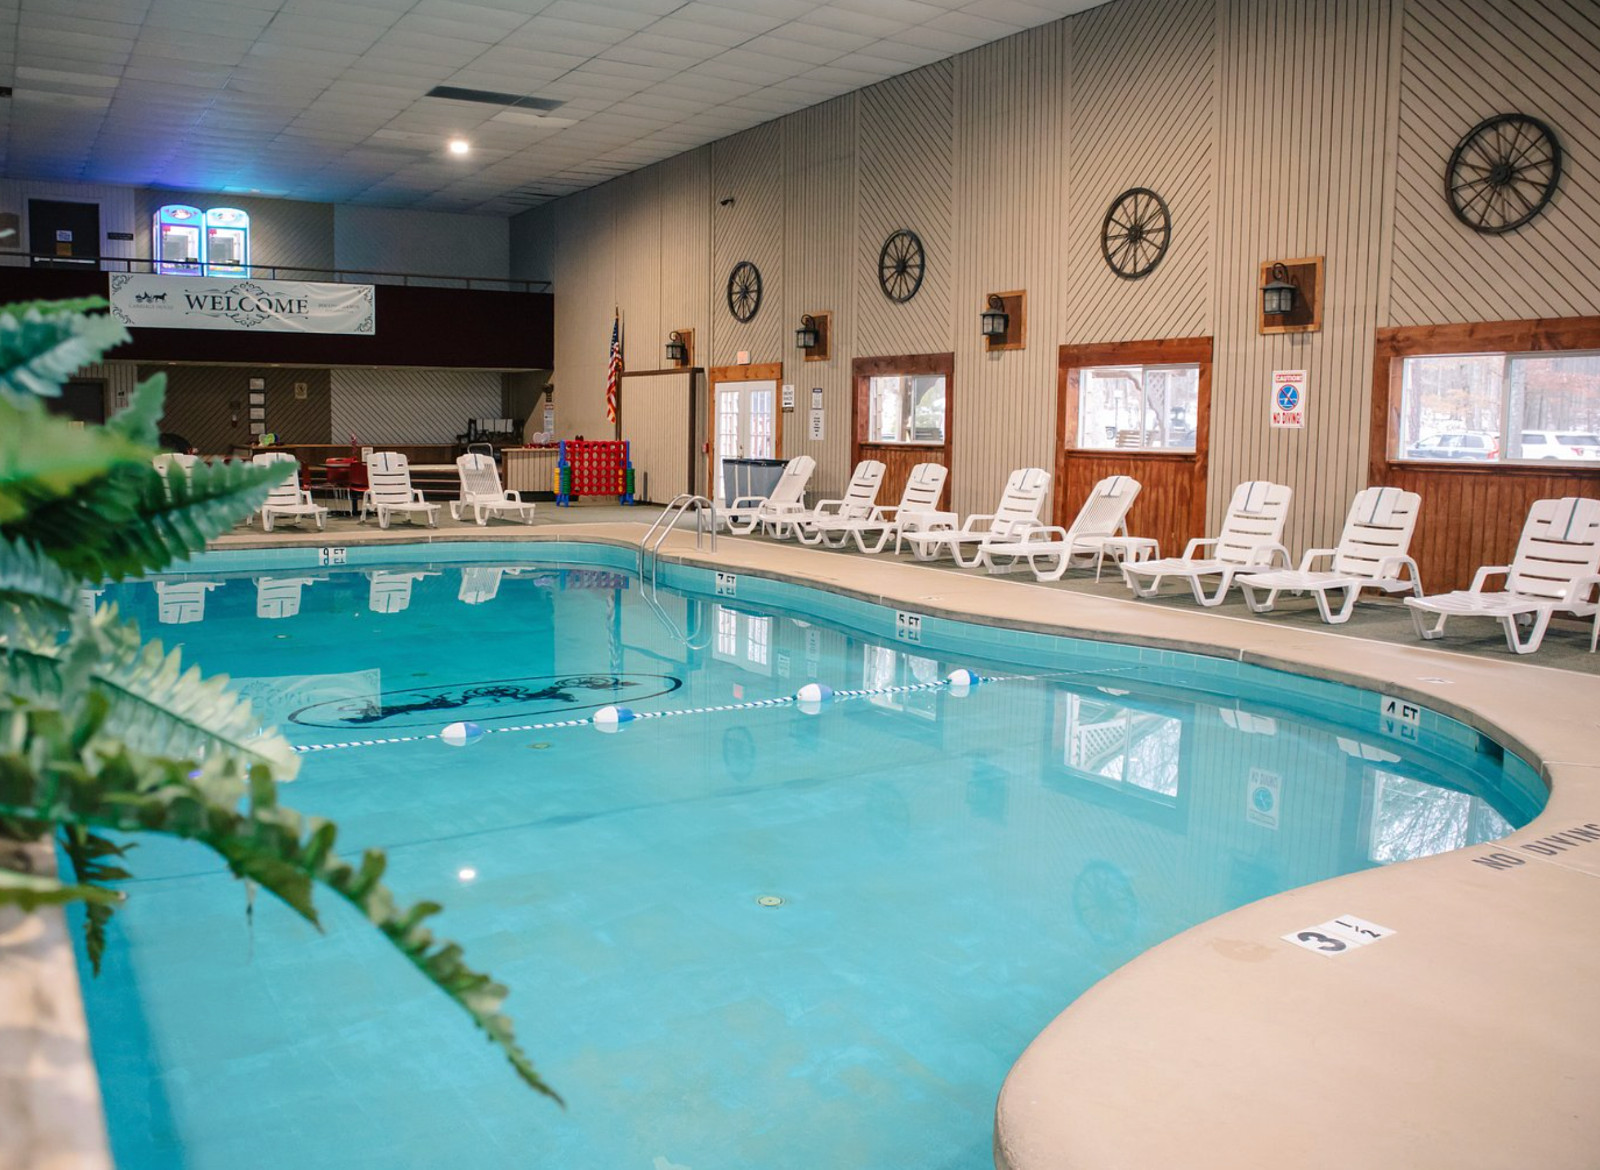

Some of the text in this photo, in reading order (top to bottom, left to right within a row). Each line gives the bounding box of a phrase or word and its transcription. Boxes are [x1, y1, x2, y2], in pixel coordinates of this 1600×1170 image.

[184, 293, 309, 314] WELCOME
[1273, 412, 1280, 424] NO
[1472, 852, 1526, 871] NO
[1296, 931, 1347, 952] 3
